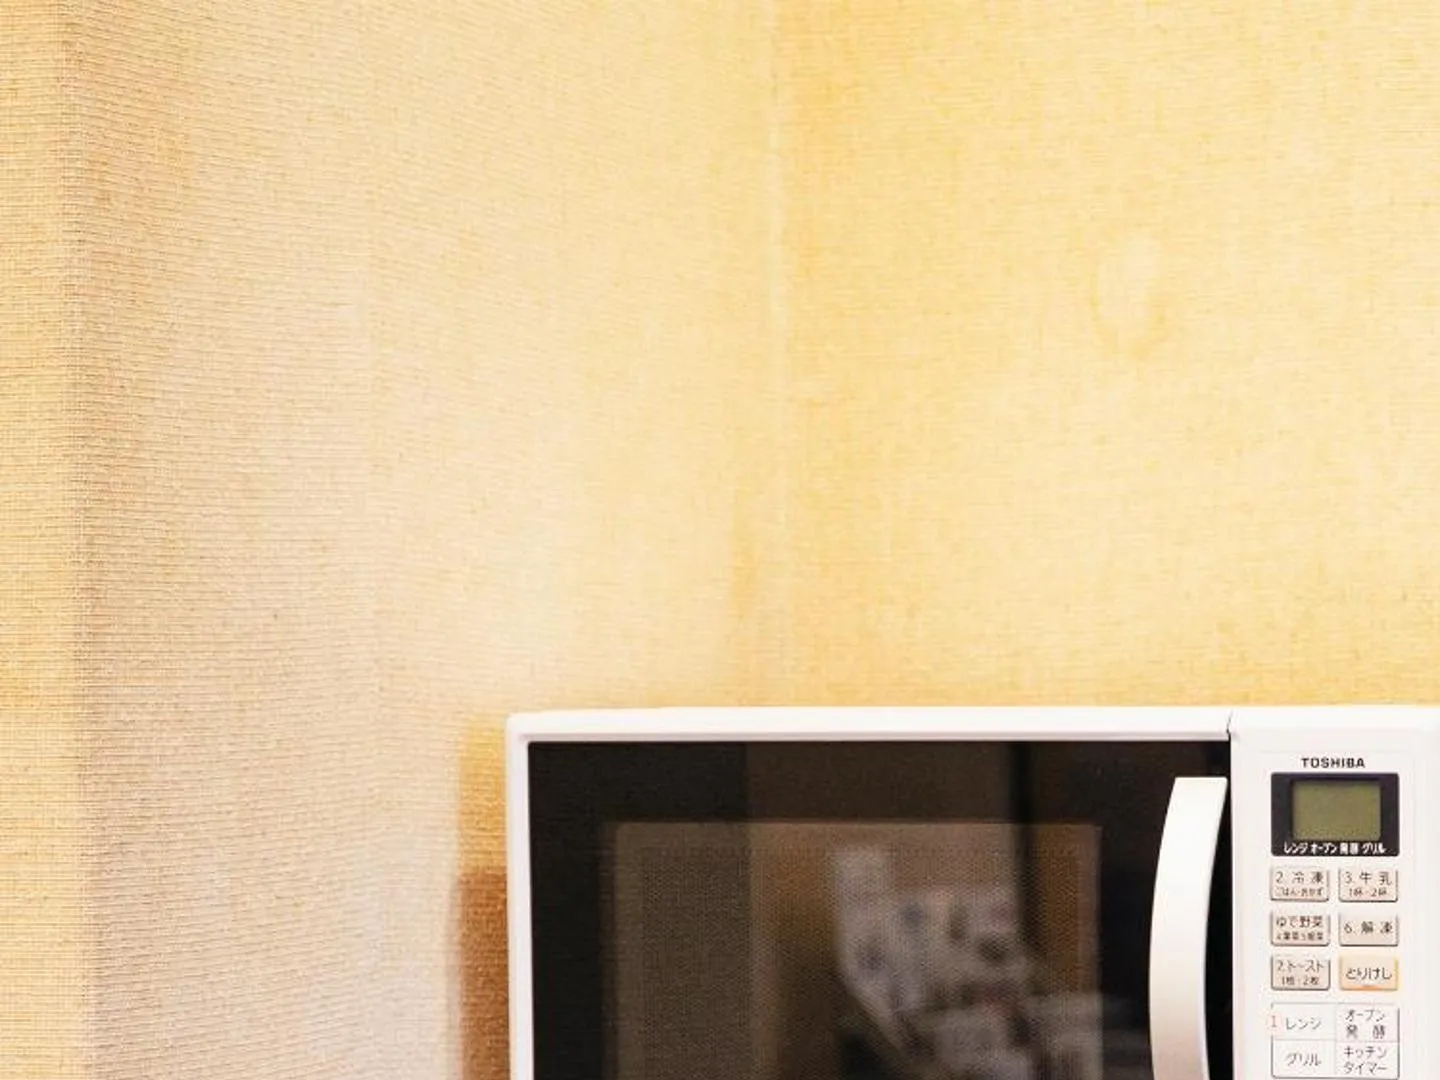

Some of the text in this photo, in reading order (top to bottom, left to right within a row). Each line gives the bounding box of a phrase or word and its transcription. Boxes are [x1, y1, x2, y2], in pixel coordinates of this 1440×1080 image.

[1301, 757, 1366, 769] TOSHIBA
[1283, 841, 1309, 854] レンジ
[1361, 842, 1386, 854] グリル
[1285, 1016, 1321, 1030] レンジ
[1286, 1052, 1322, 1066] グリル
[1344, 1045, 1387, 1059] キッチン
[1344, 1061, 1388, 1075] タイマー
